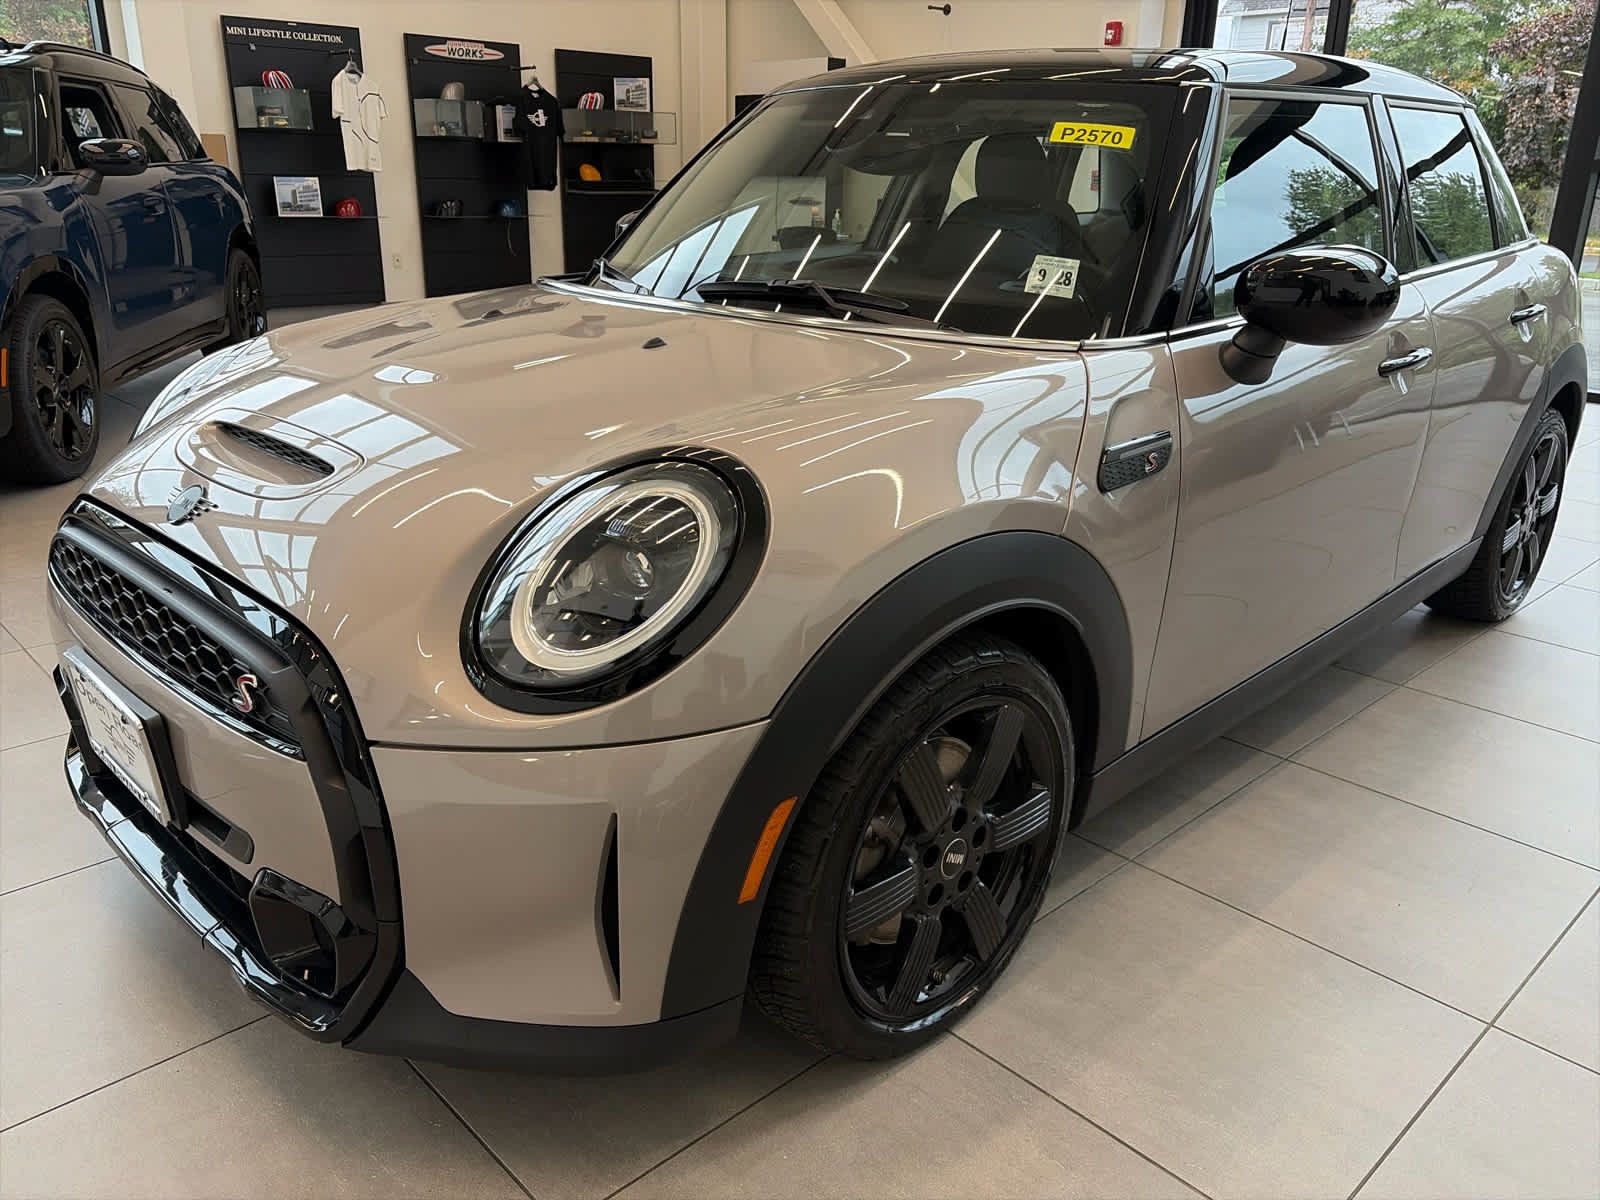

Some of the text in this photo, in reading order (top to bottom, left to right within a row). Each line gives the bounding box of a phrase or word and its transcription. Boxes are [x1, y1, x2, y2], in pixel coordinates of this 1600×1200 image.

[226, 26, 247, 36] MINI
[248, 28, 292, 39] LIFESTYLE
[447, 47, 485, 58] WORKS
[1060, 127, 1123, 145] P2570
[1038, 269, 1047, 282] 9
[1145, 452, 1159, 473] S
[232, 674, 258, 713] S
[946, 852, 965, 865] MINI
